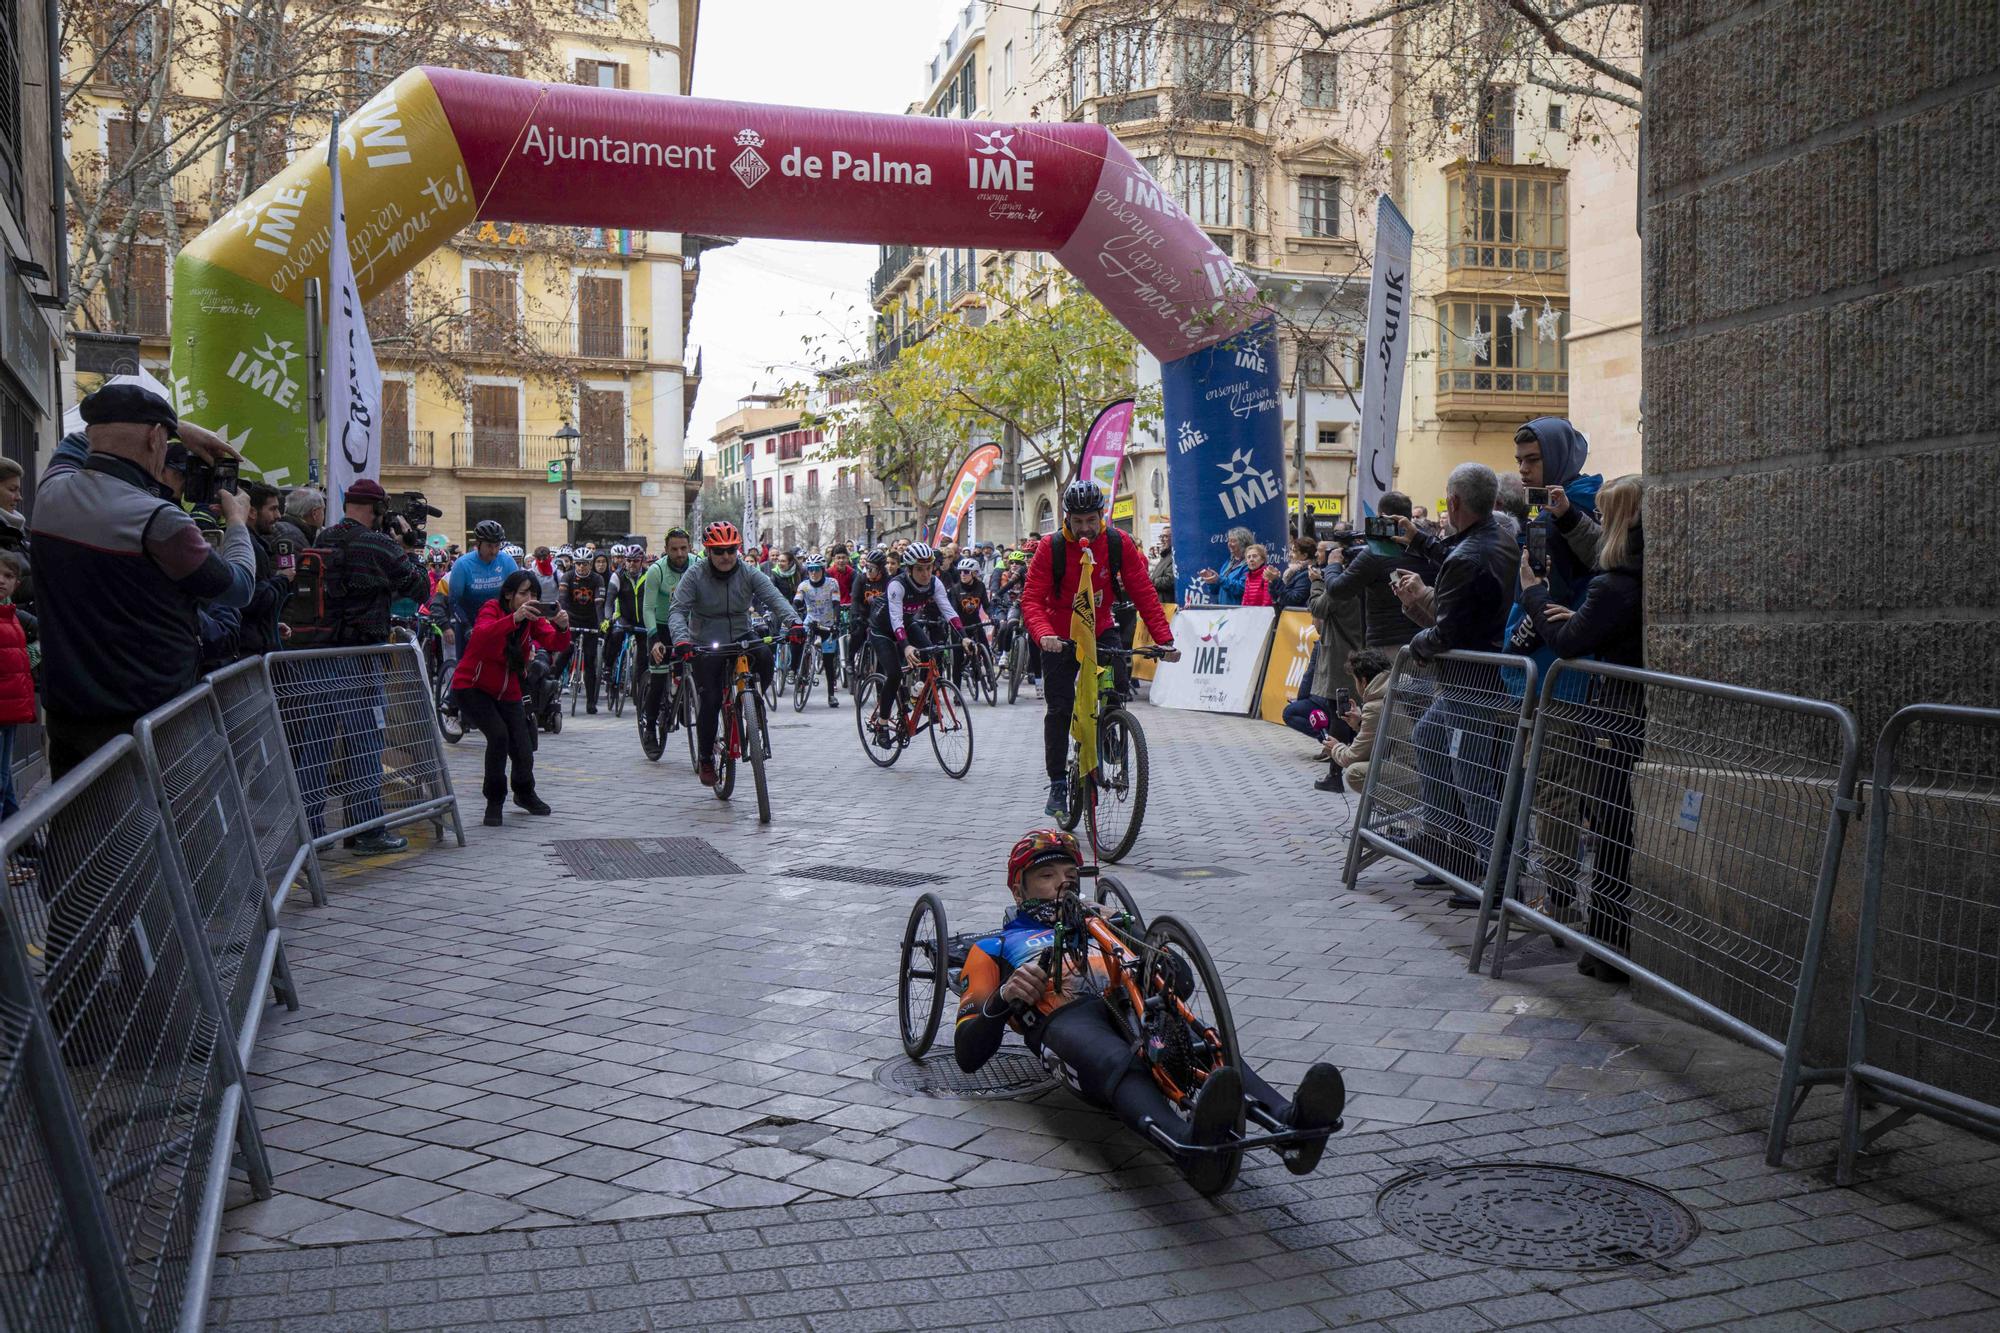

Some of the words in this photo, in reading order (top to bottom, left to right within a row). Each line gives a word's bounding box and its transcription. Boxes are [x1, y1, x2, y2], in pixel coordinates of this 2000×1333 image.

[522, 124, 716, 171] Ajuntament
[780, 146, 822, 178] de
[832, 150, 931, 186] Palma
[968, 157, 1034, 191] IME
[1125, 176, 1176, 218] IME
[254, 186, 307, 256] IME
[1094, 189, 1164, 250] ensenya
[201, 302, 260, 318] mou-te!
[1235, 351, 1266, 373] IME
[227, 351, 299, 409] IME
[1205, 380, 1249, 411] ensenya
[1178, 430, 1204, 454] IME
[1218, 469, 1279, 519] IME
[1317, 499, 1337, 510] Vila
[1192, 646, 1228, 675] IME
[1285, 656, 1310, 688] IM
